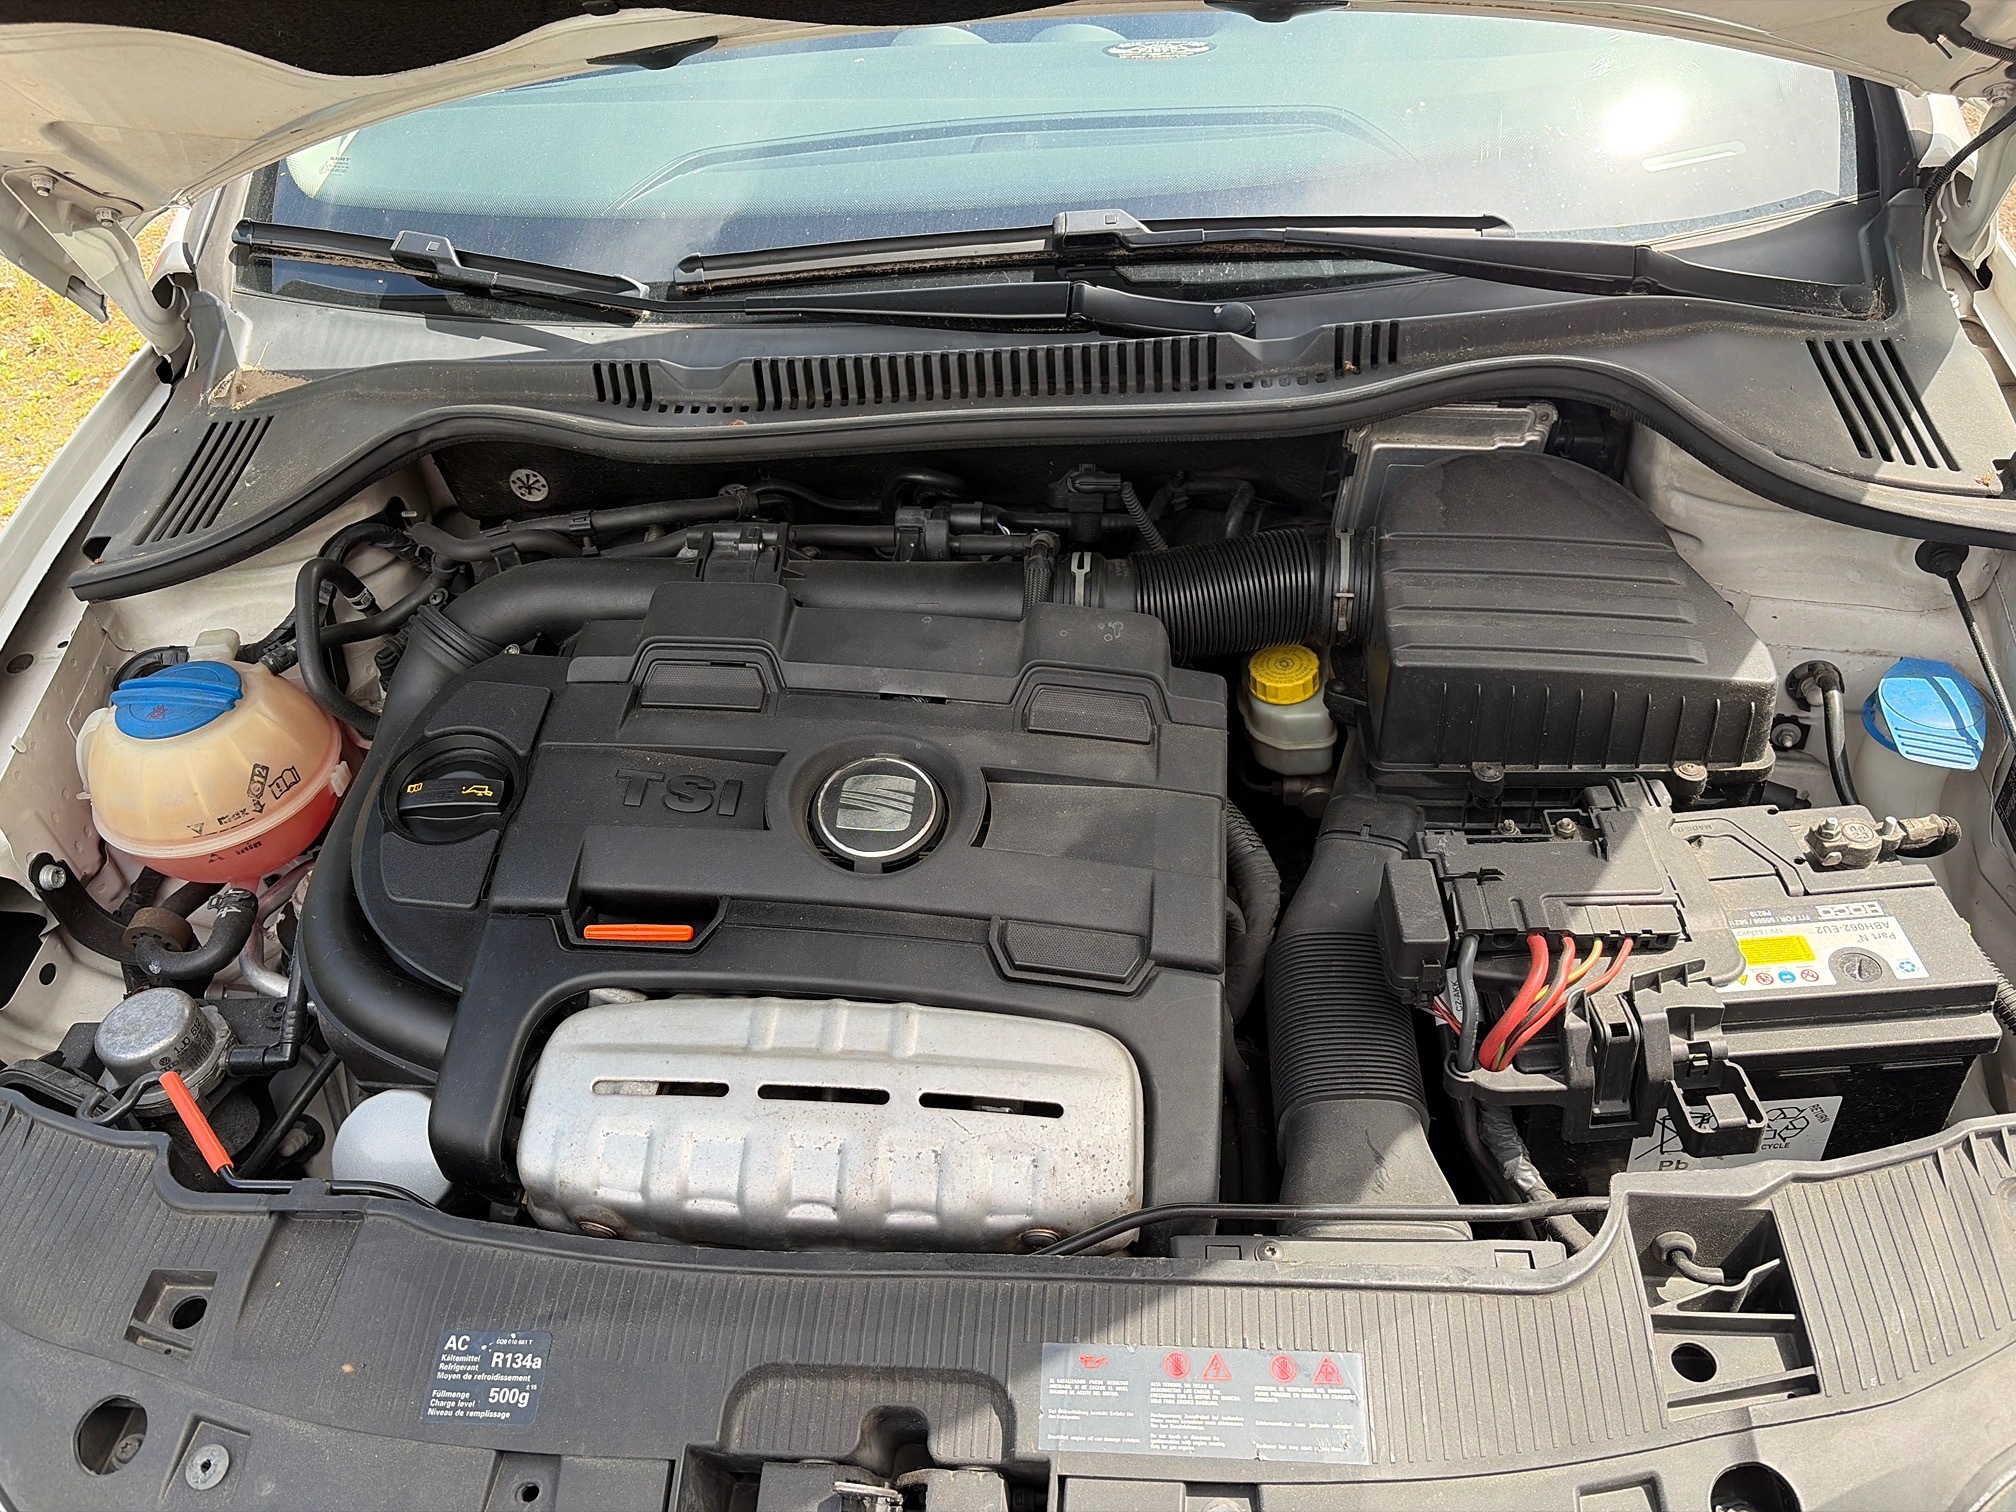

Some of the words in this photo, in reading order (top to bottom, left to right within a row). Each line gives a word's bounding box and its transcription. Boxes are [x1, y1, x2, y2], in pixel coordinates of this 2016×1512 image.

[615, 767, 744, 817] TSI
[1815, 921, 1889, 934] ABH062-EU2
[1871, 932, 1896, 941] Part
[1658, 1160, 1689, 1171] Pb
[444, 1335, 470, 1350] AC
[441, 1353, 481, 1363] Kältemittel
[491, 1352, 542, 1369] R134a
[439, 1363, 479, 1372] Refrigerant
[437, 1372, 461, 1381] Moyen
[474, 1374, 531, 1382] refroidissement
[432, 1390, 470, 1399] Füllmenge
[488, 1388, 530, 1408] 500g
[430, 1399, 455, 1408] Charge
[457, 1400, 475, 1408] level
[427, 1408, 453, 1416] Niveau
[466, 1410, 510, 1419] remplissage
